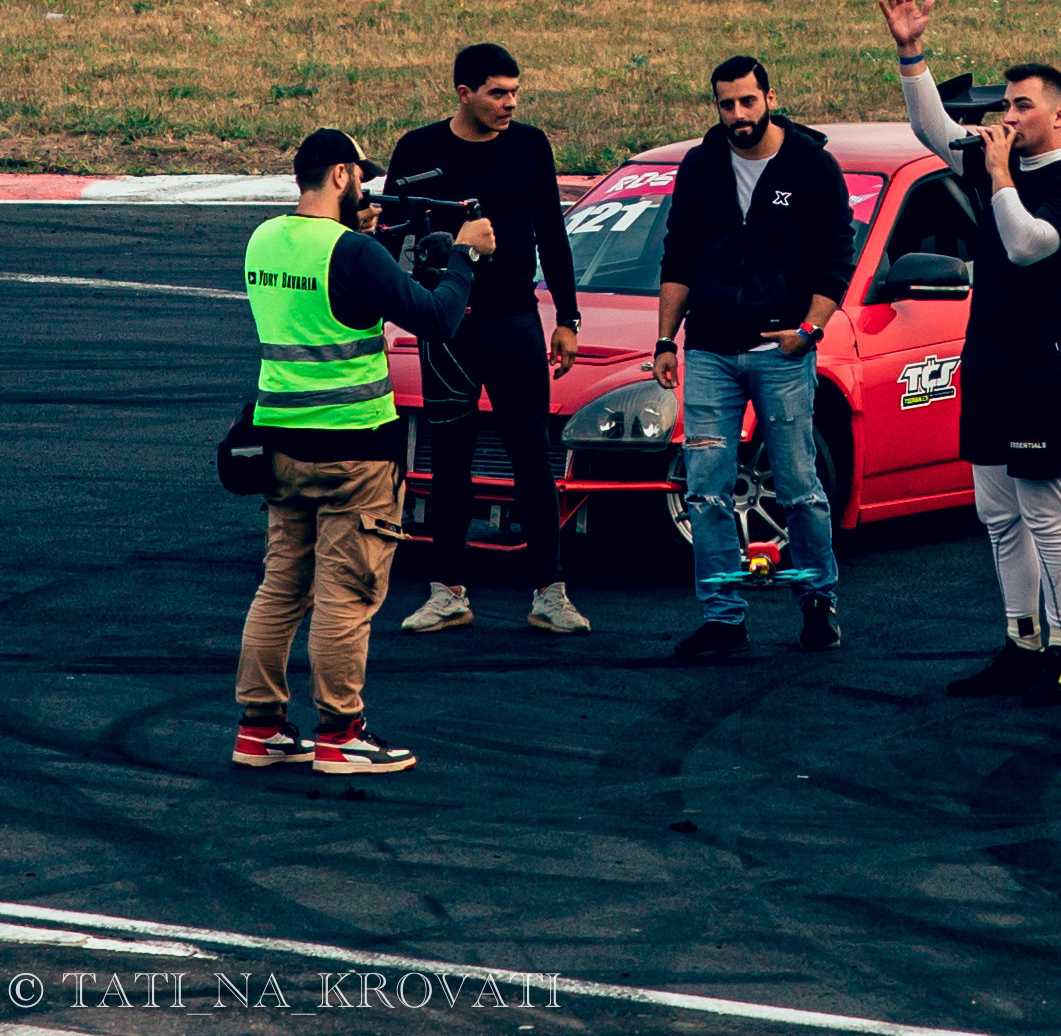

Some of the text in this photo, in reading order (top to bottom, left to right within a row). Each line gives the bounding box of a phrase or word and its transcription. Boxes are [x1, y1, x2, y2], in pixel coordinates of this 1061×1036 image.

[606, 170, 678, 194] RDS
[566, 201, 652, 235] 121
[904, 358, 958, 394] TCS
